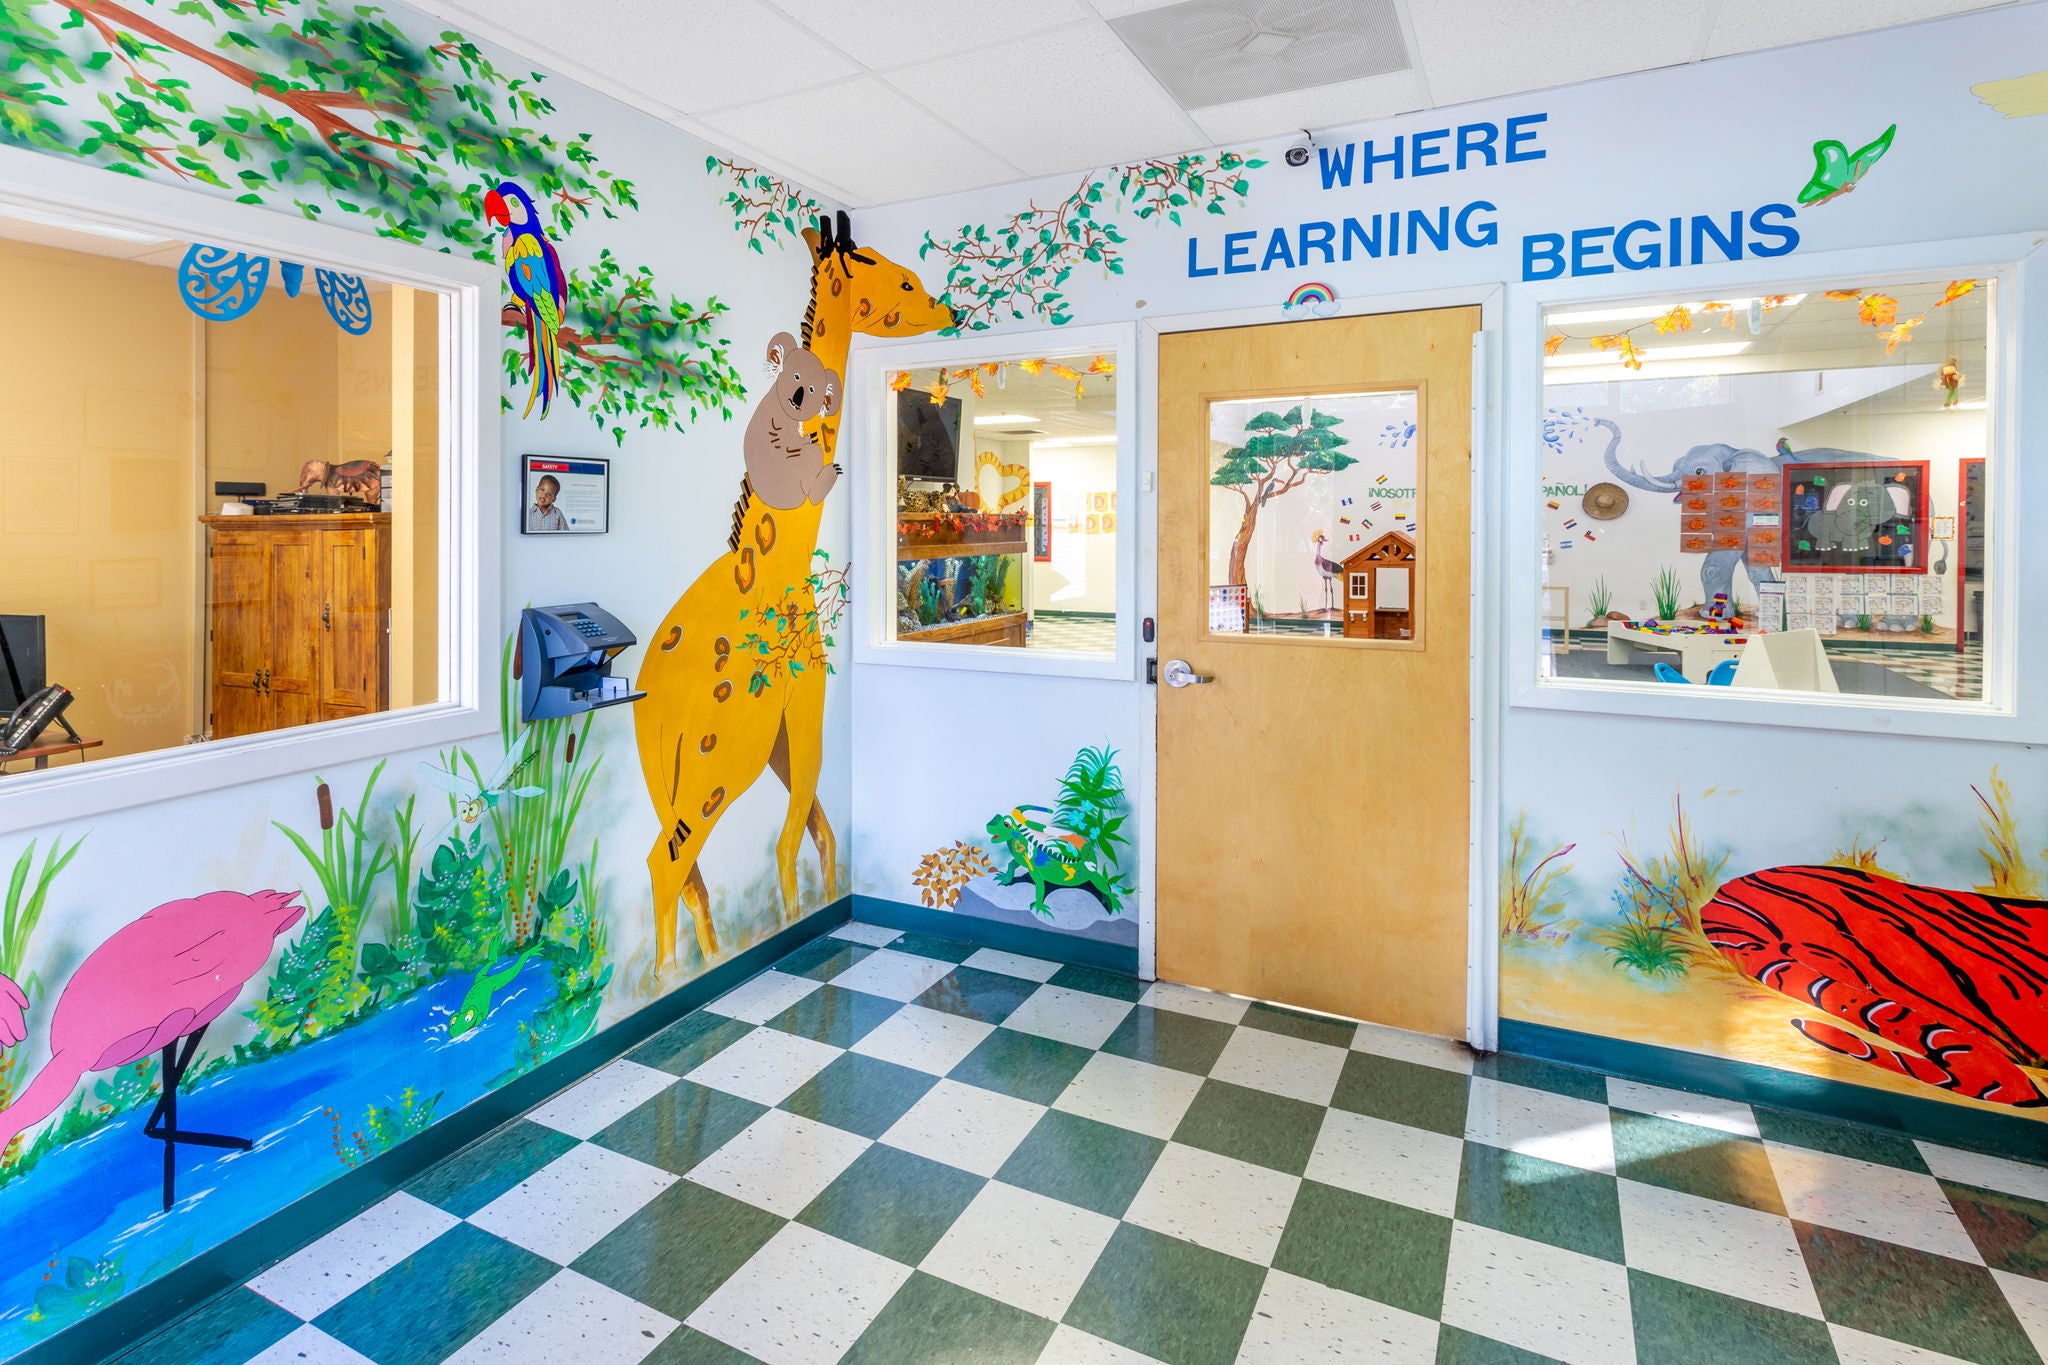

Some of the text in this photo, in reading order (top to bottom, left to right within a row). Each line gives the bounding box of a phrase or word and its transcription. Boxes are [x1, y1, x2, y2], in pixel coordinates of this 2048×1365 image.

[1318, 112, 1548, 190] WHERE
[1188, 200, 1801, 282] LEARNING BEGINS
